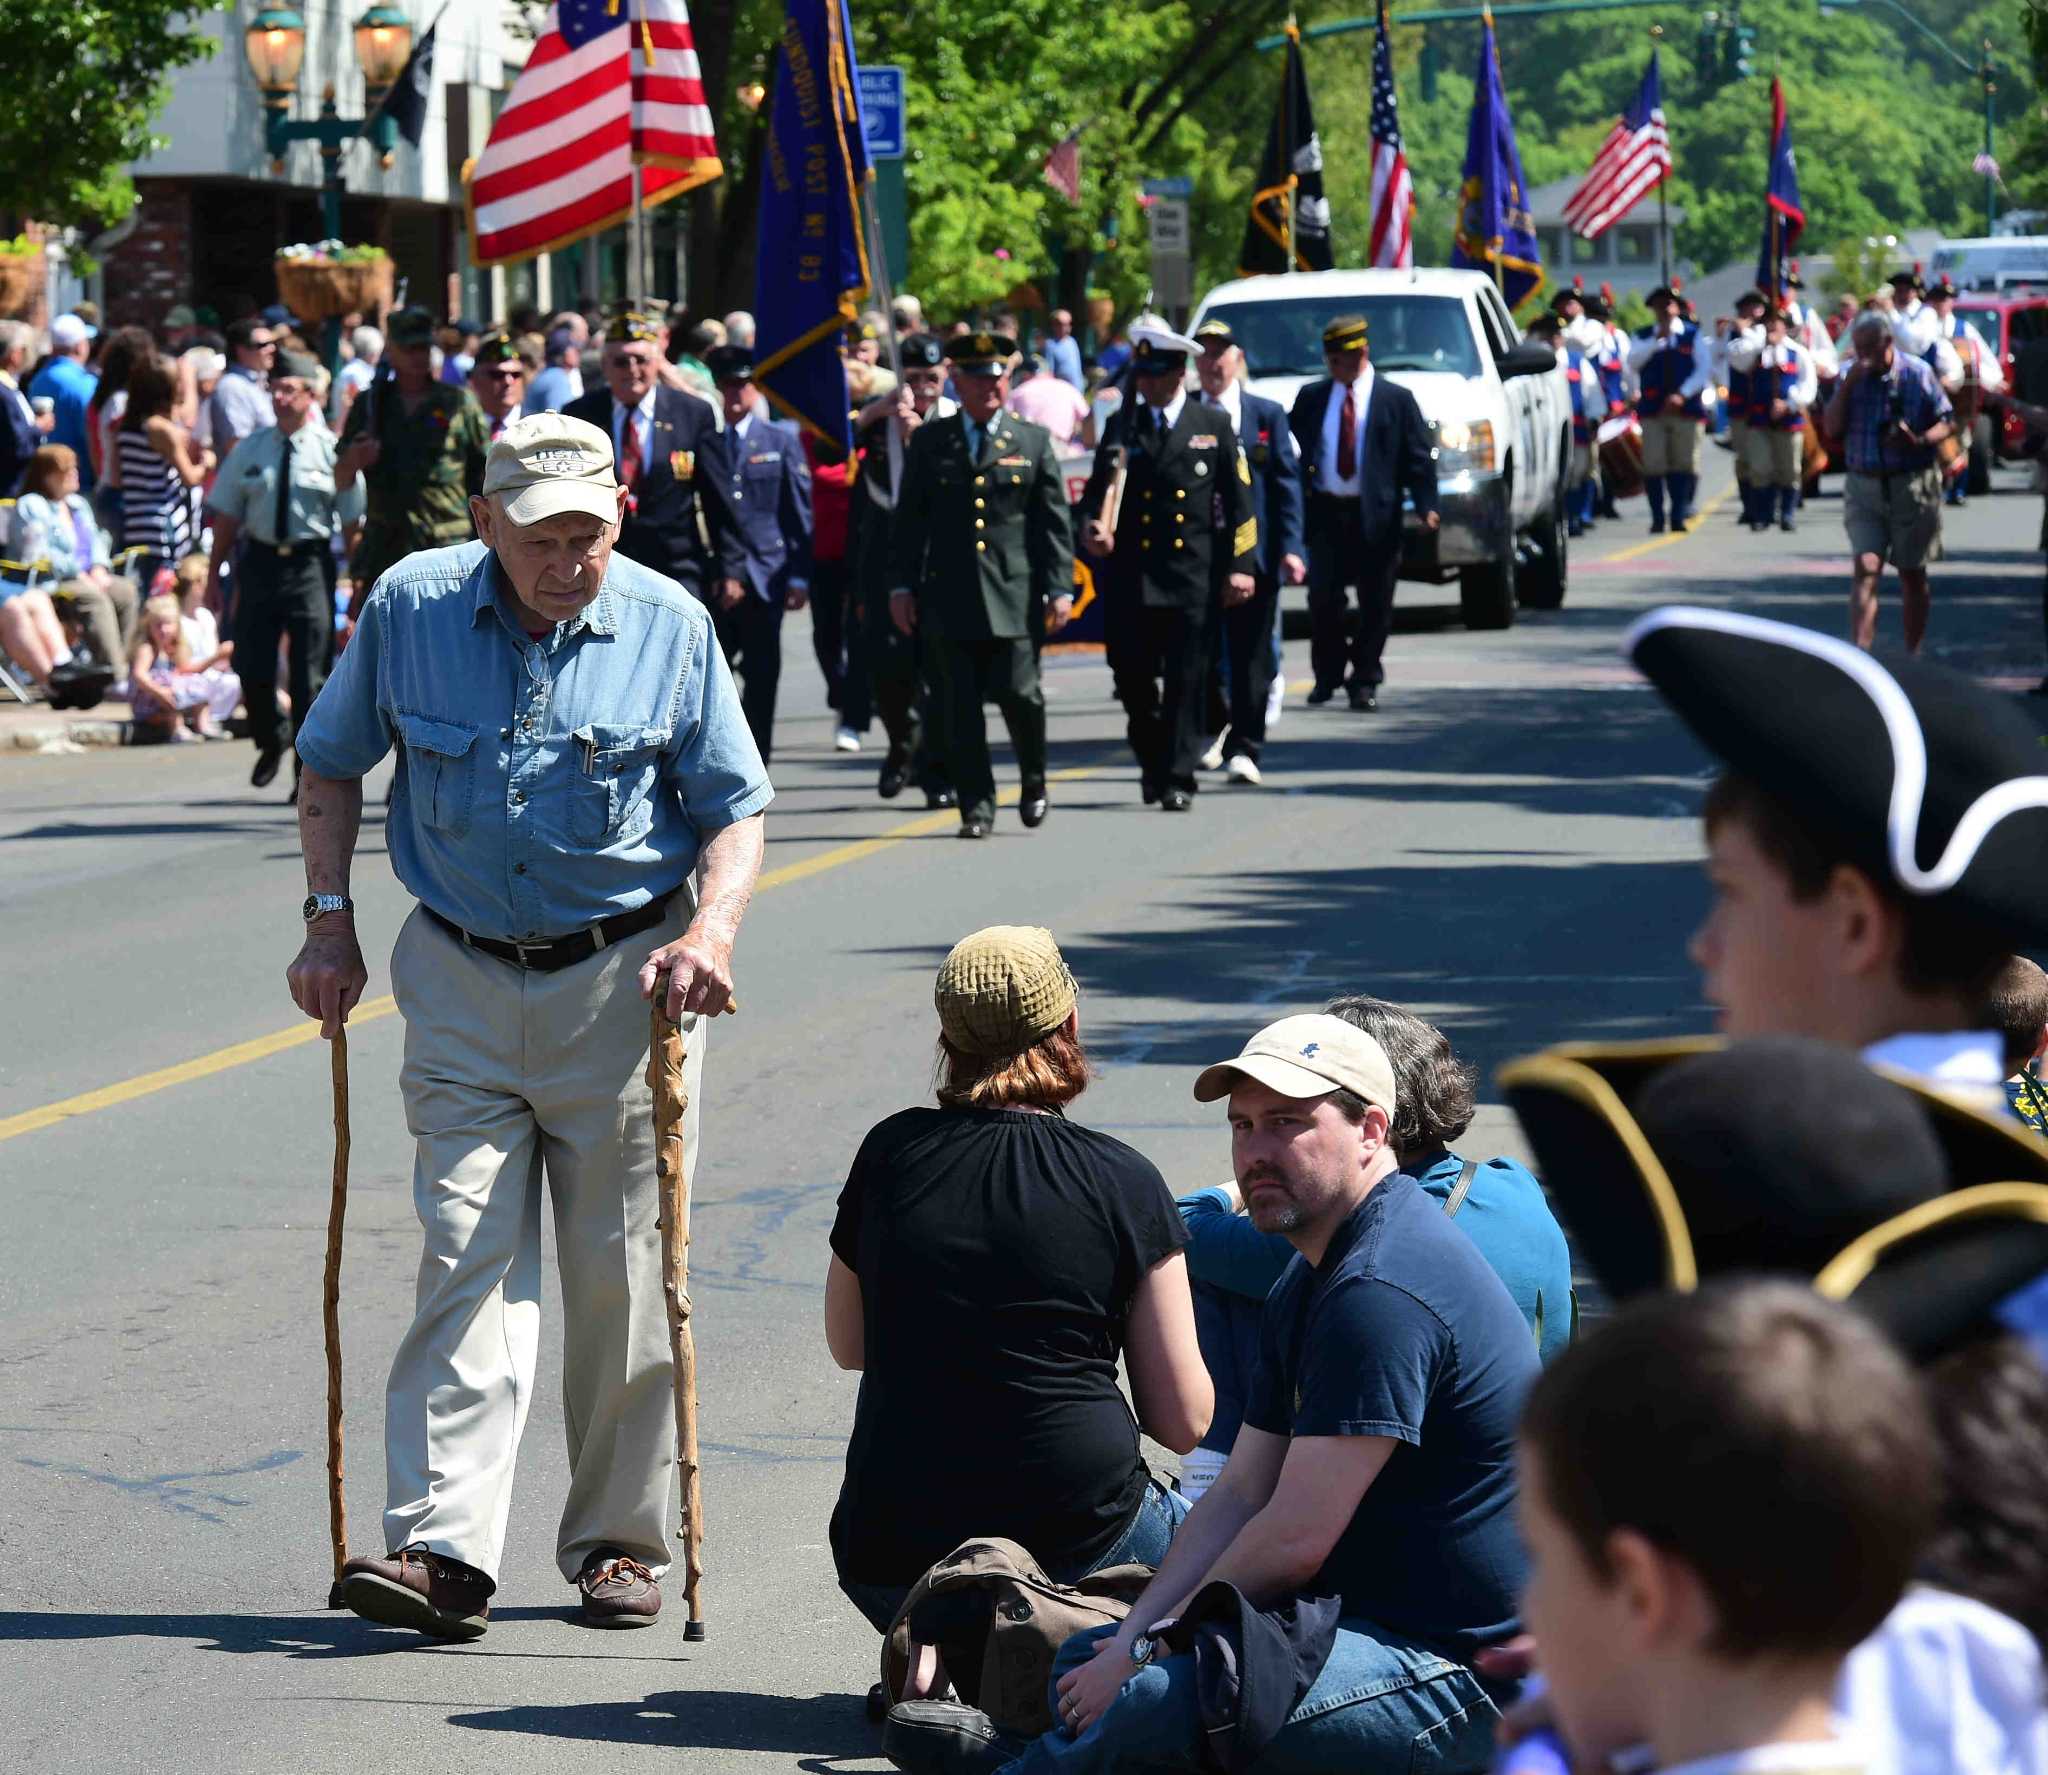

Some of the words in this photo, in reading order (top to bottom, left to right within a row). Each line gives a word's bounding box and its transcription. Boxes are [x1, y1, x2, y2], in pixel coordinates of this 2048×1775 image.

[861, 75, 892, 90] BLIC
[804, 144, 827, 193] POST
[535, 450, 585, 461] USA
